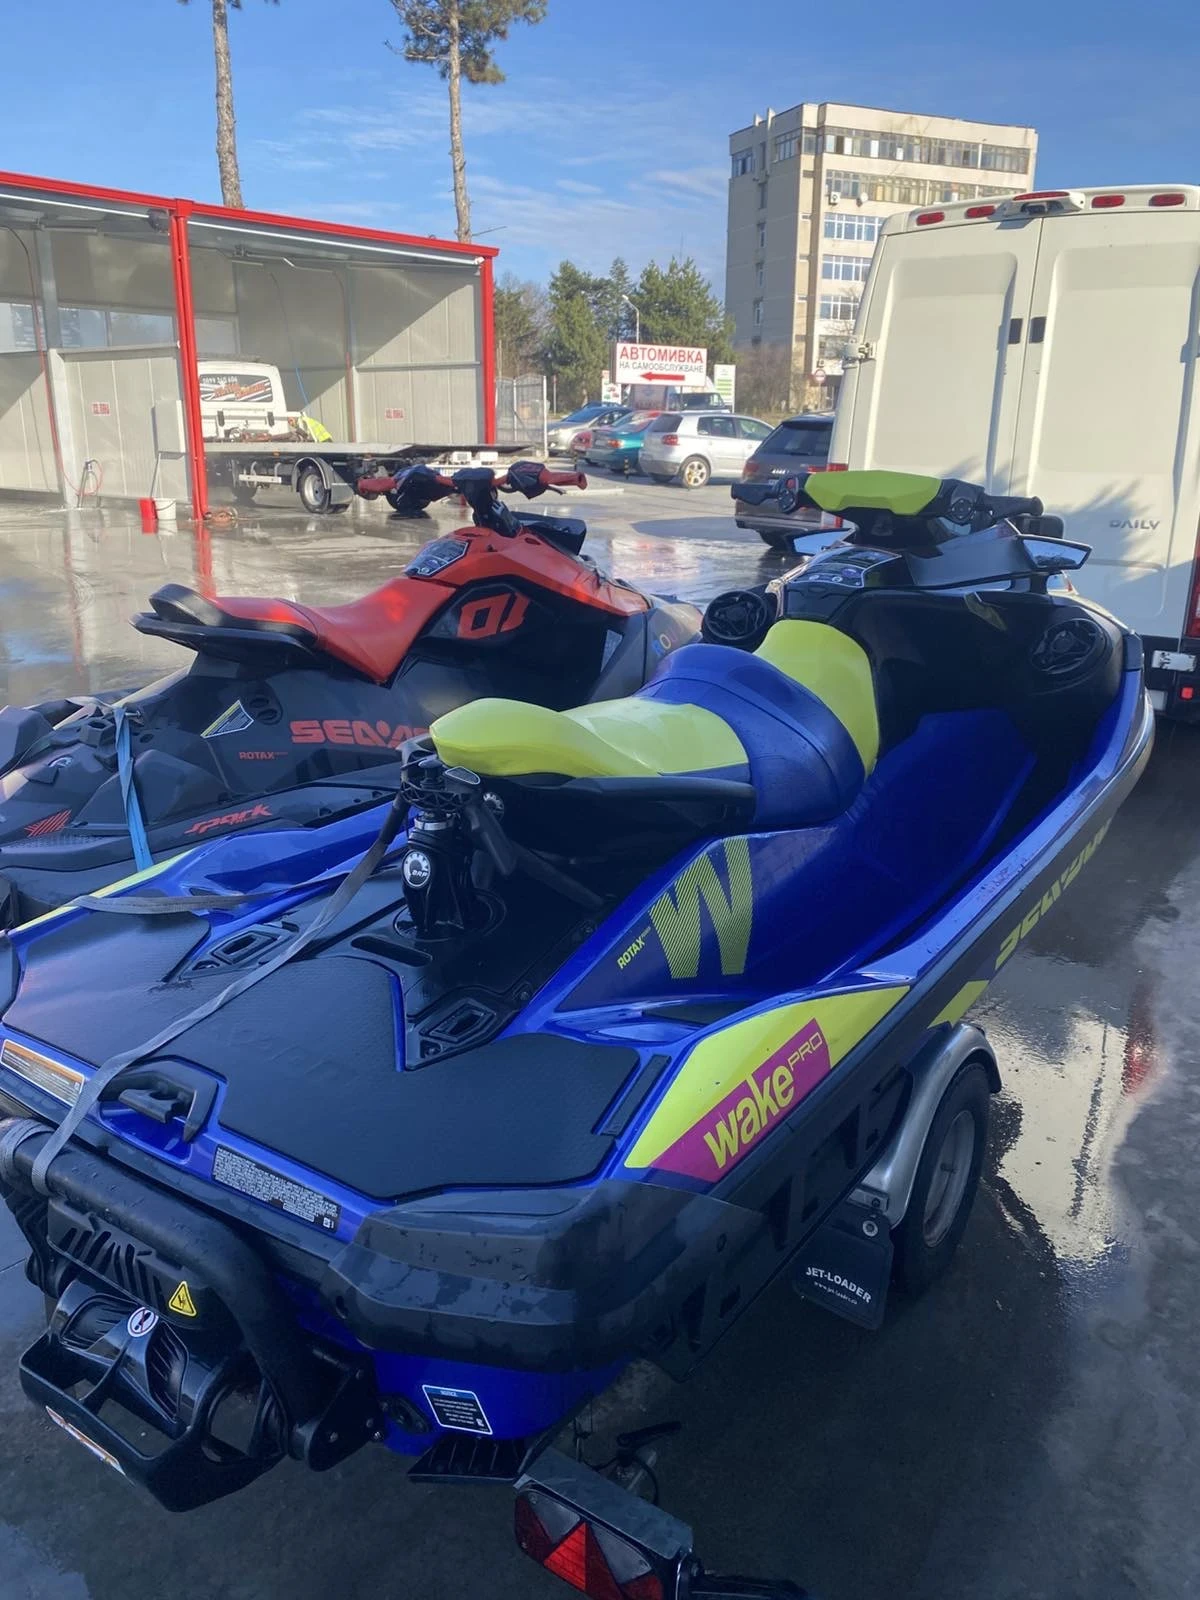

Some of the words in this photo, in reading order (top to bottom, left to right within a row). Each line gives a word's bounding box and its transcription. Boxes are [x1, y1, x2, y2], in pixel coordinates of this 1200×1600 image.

[620, 347, 704, 364] АВТОМИВКА
[632, 362, 704, 373] САМООБСЛУЖВАНЕ
[1108, 519, 1160, 530] DAILY
[239, 751, 275, 760] ROTAX
[616, 936, 646, 970] ROTAX
[703, 1065, 794, 1169] wake
[787, 1031, 823, 1071] PRO
[805, 1266, 872, 1304] JET-LOADER
